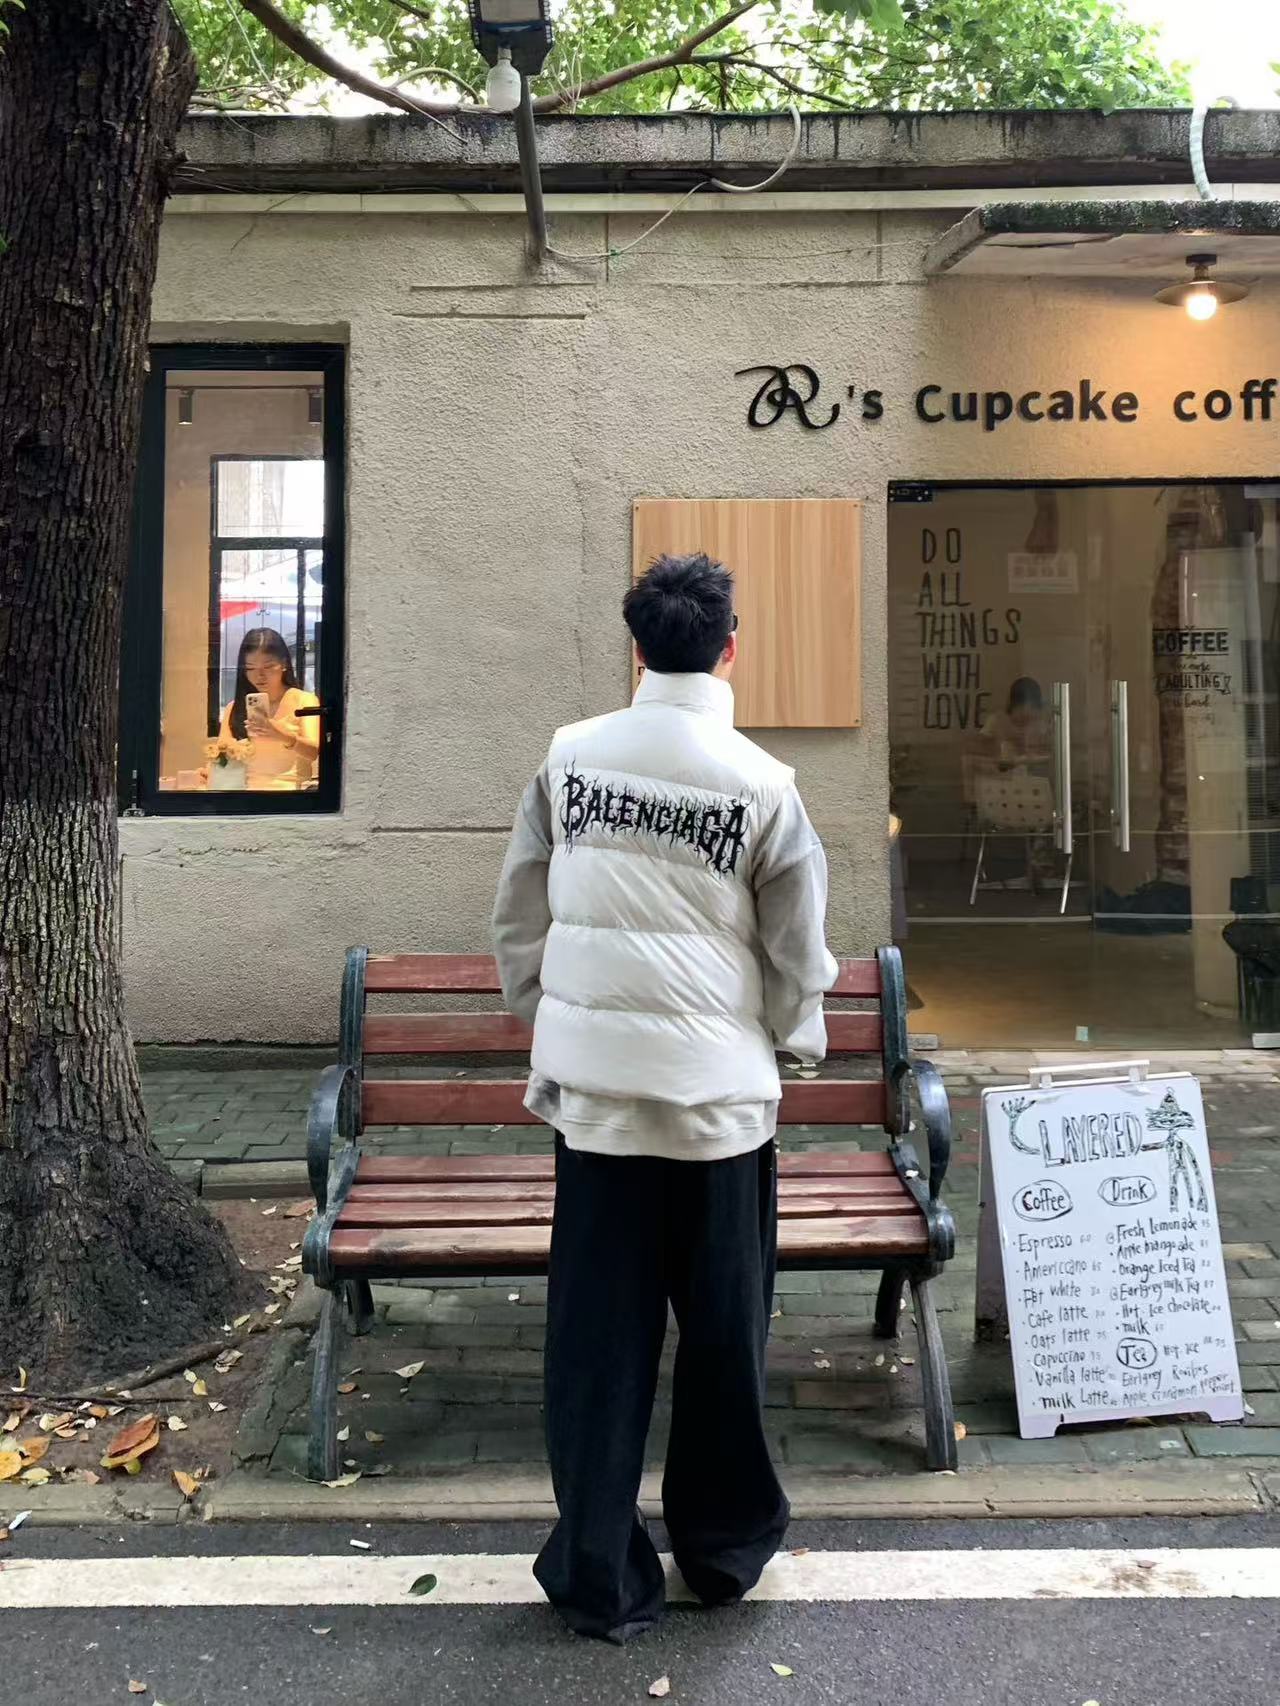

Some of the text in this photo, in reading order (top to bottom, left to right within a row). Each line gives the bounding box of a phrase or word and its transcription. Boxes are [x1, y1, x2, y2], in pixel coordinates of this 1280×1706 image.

[916, 379, 1139, 431] Cupcake
[1173, 378, 1278, 422] coff
[922, 527, 961, 564] DO
[918, 571, 971, 607] ALL
[915, 608, 1021, 648] THINGS
[1152, 631, 1229, 652] COFFEE
[921, 653, 981, 689] WITH
[923, 692, 992, 729] LOVE
[560, 757, 754, 877] BALENCIAGA
[1021, 1190, 1065, 1211] Coffee
[1112, 1177, 1148, 1201] Drink
[1116, 1219, 1146, 1243] Fresh
[1018, 1233, 1073, 1260] Espresso
[1050, 1280, 1081, 1297] white
[1028, 1309, 1053, 1328] Cafe
[1031, 1334, 1056, 1349] Oats
[1035, 1365, 1075, 1387] Vanilla
[1040, 1392, 1076, 1409] milk
